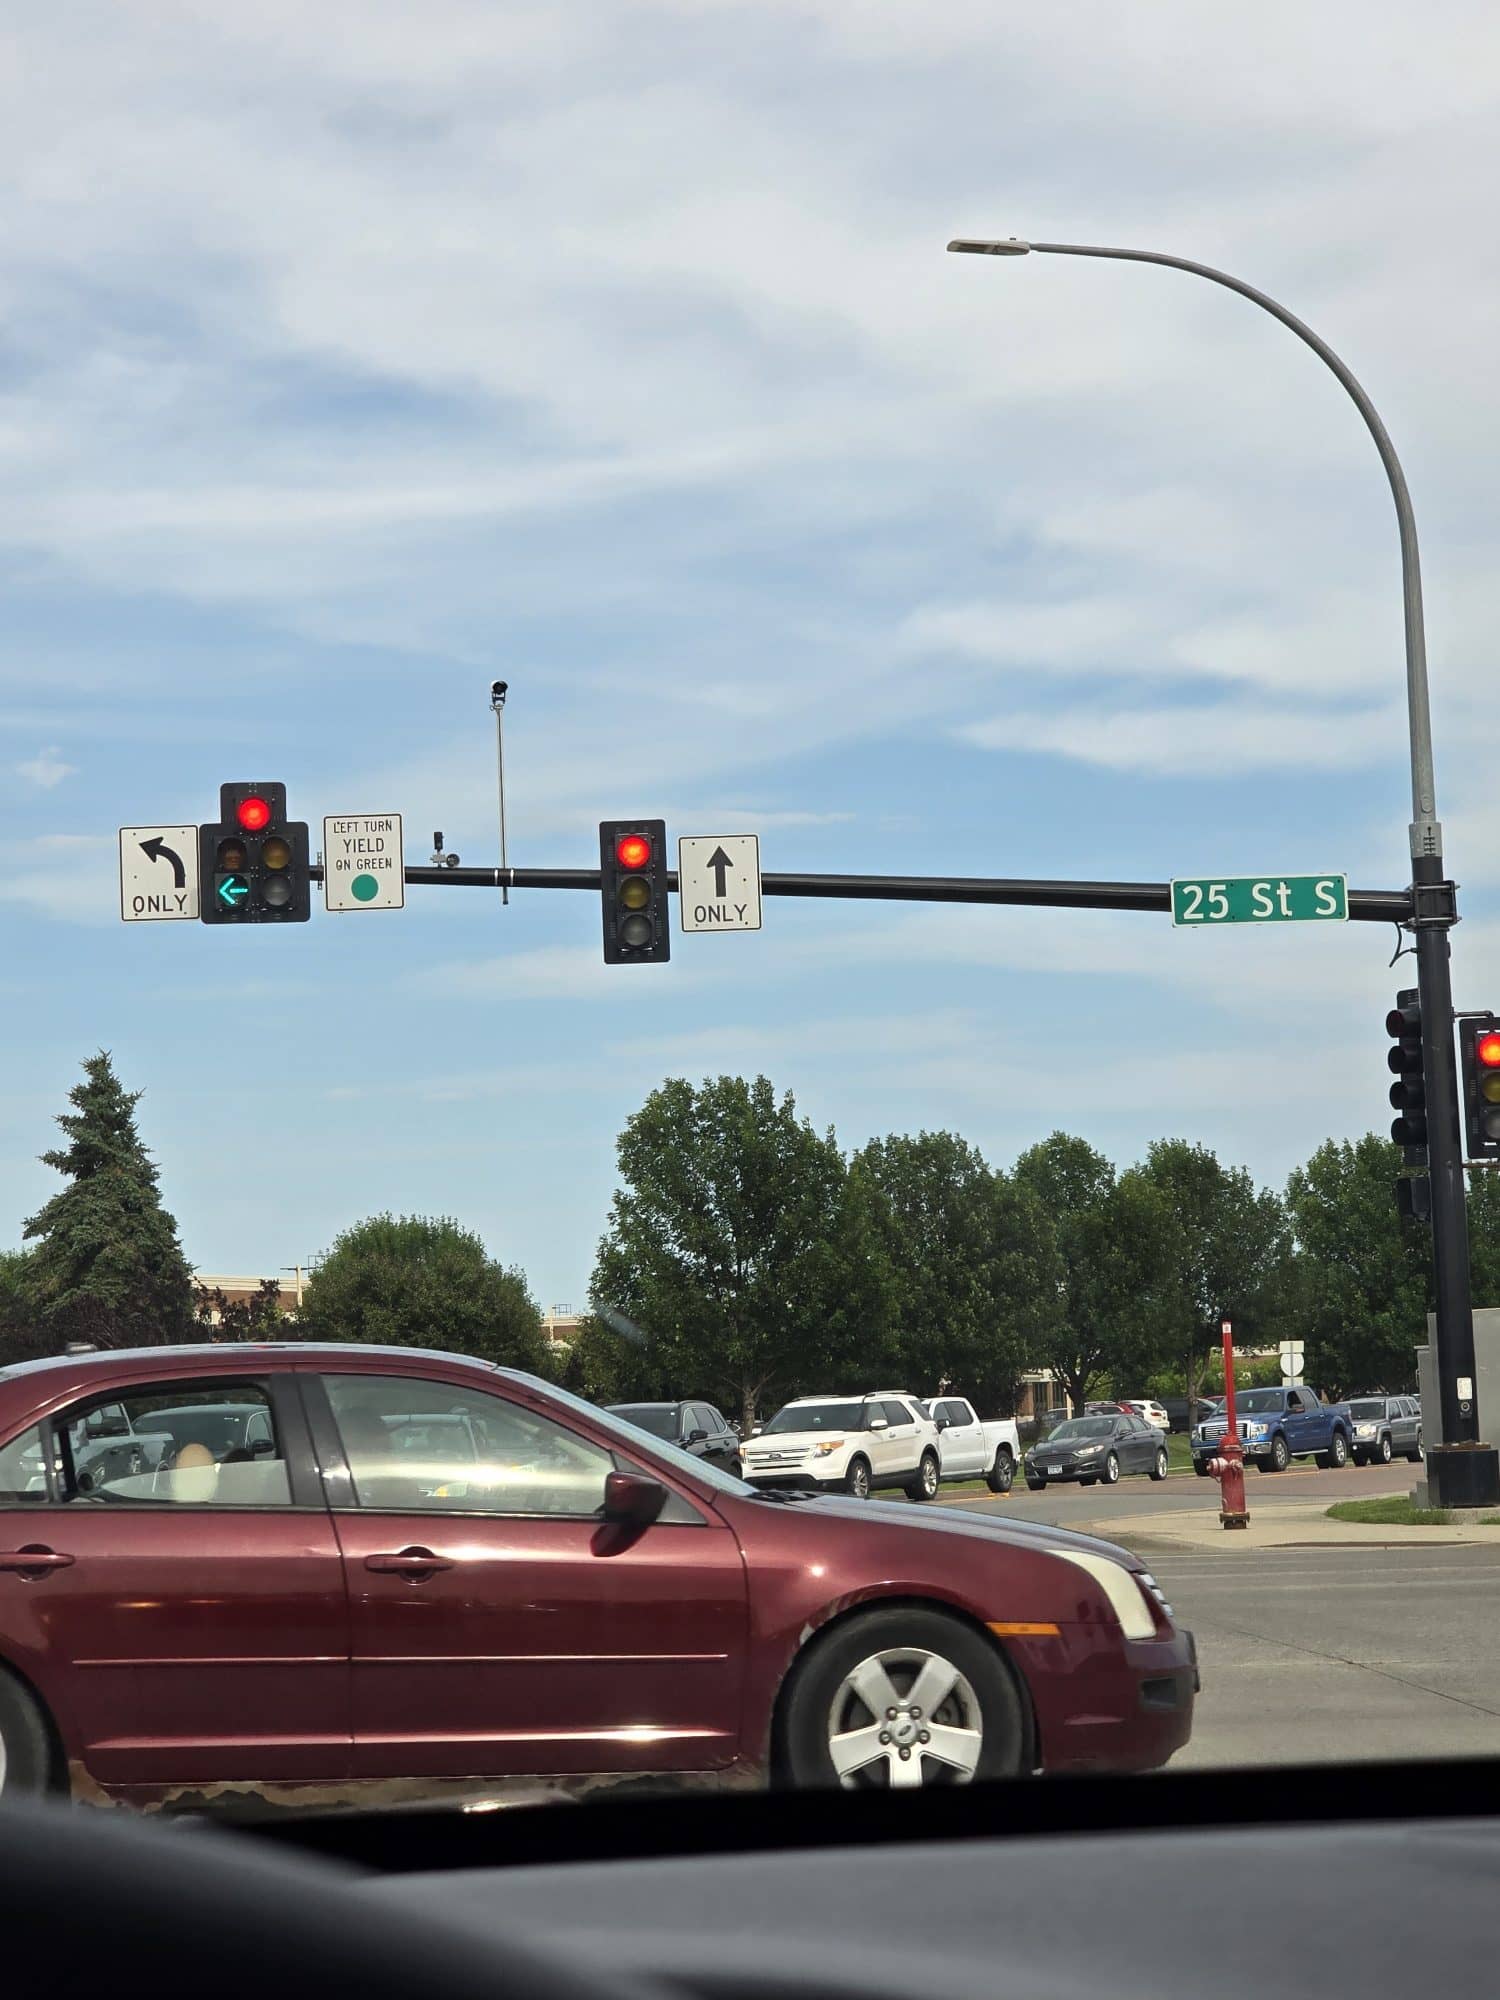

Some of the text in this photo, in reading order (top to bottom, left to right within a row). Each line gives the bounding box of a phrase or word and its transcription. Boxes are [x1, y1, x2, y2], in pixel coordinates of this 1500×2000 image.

[333, 819, 392, 834] LEFT TURN
[343, 837, 384, 853] YIELD
[335, 857, 392, 871] ON GREEN
[132, 894, 188, 913] ONLY
[1182, 880, 1337, 920] 25 St S
[694, 904, 748, 923] ONLY
